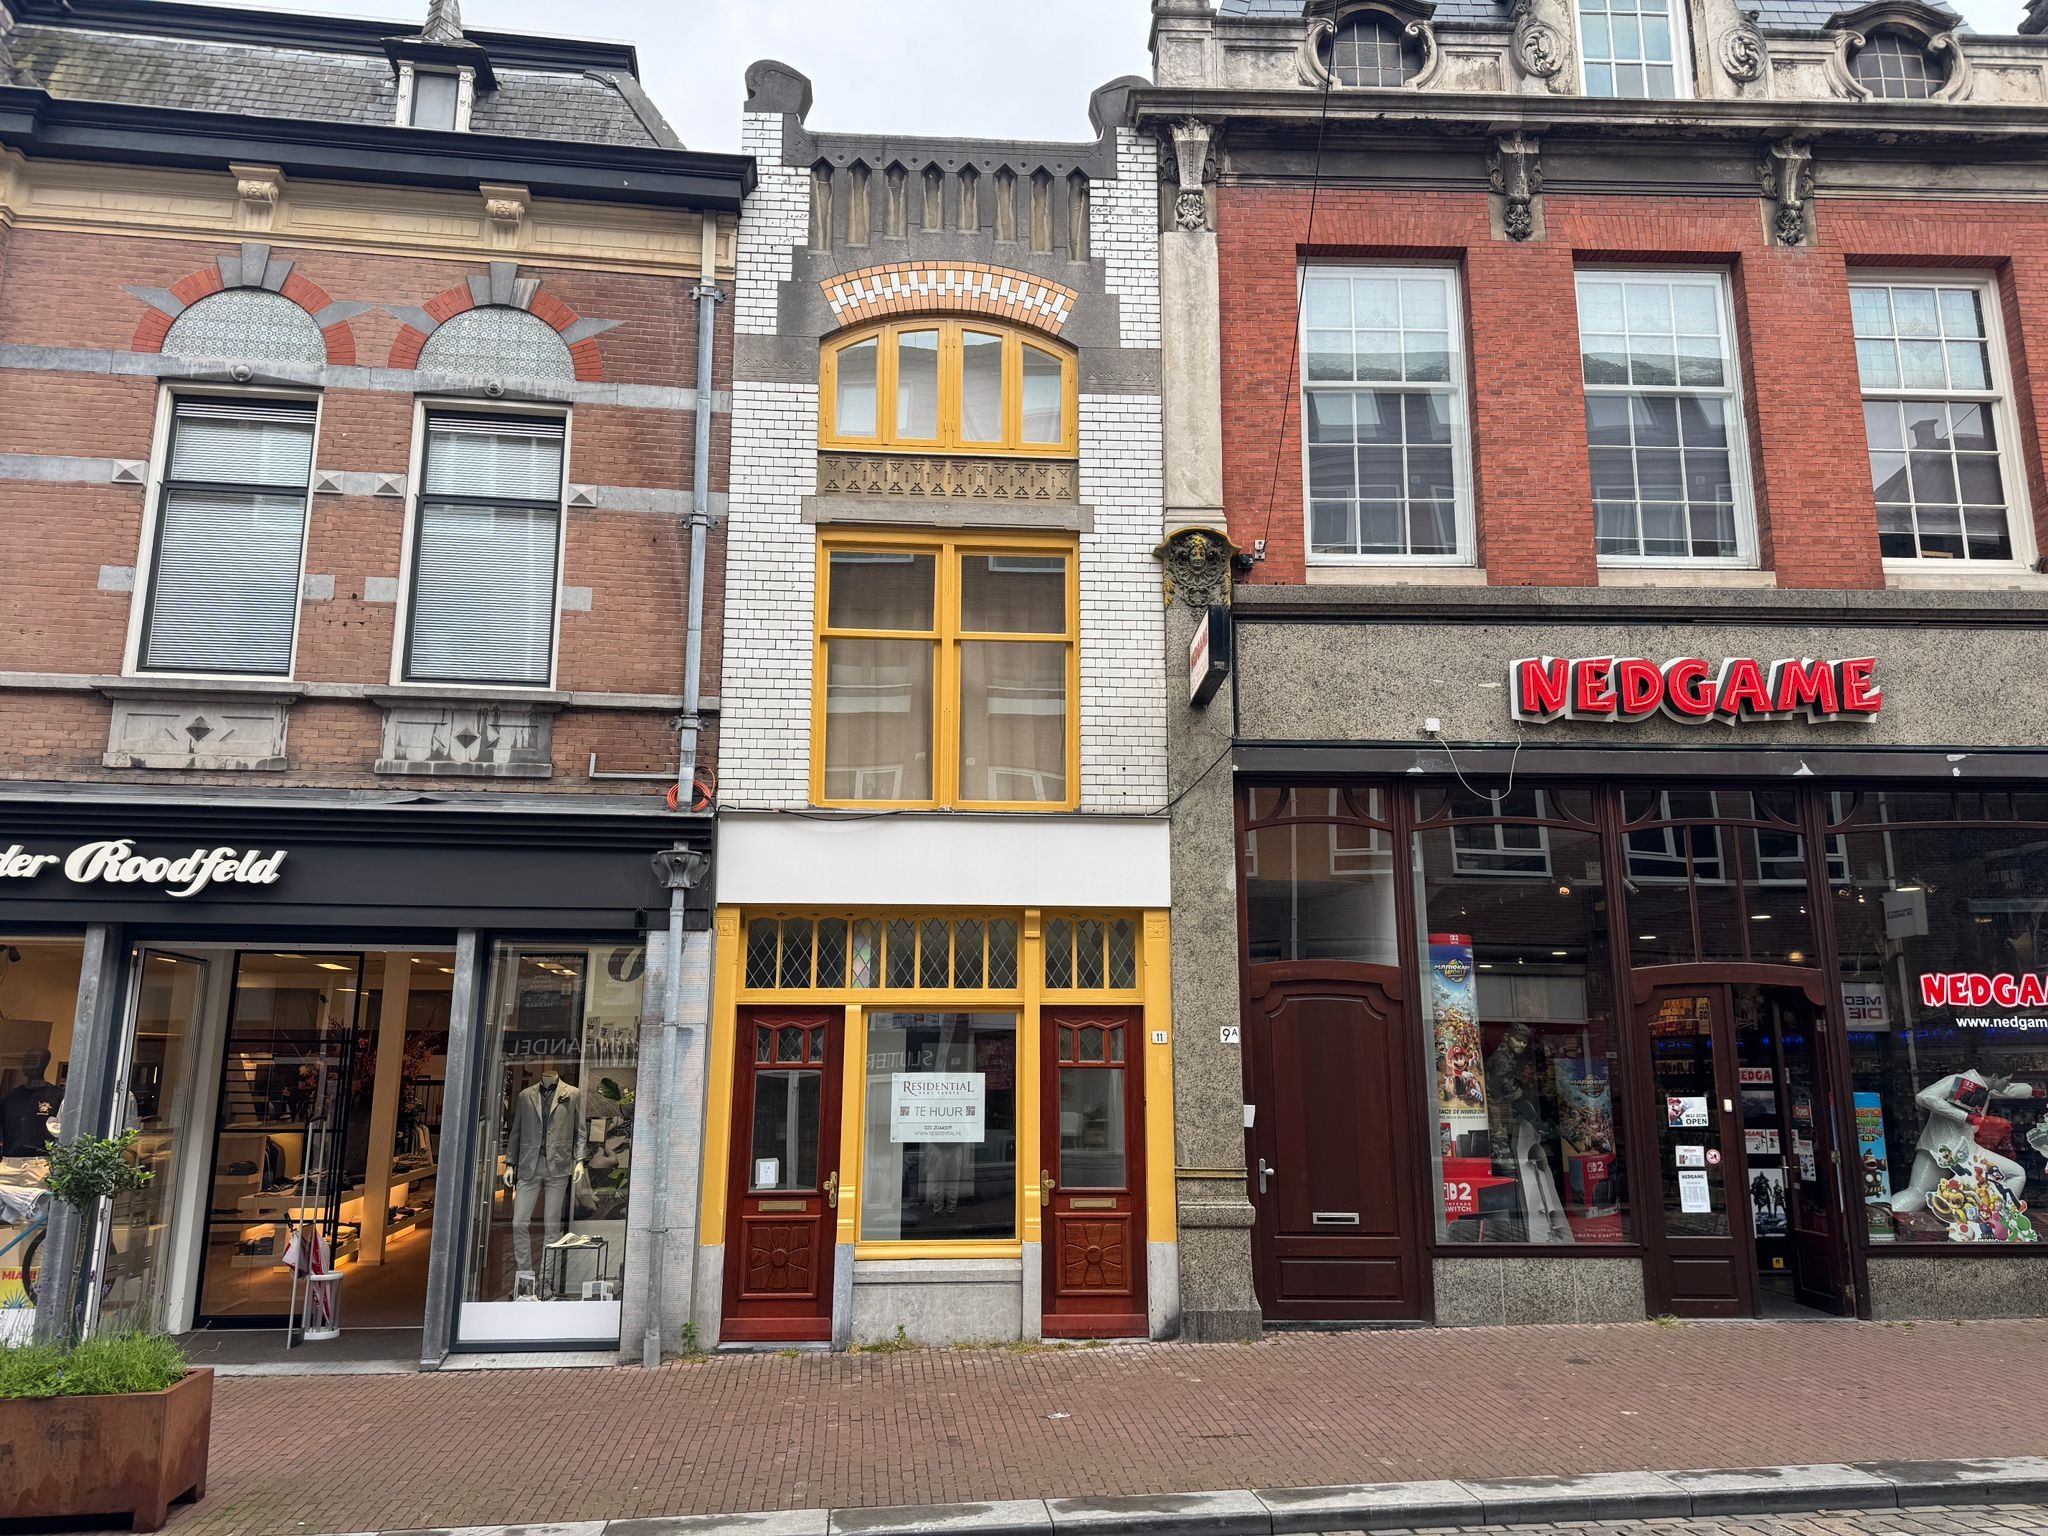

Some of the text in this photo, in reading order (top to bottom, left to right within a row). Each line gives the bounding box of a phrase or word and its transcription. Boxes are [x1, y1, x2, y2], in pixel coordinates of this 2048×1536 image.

[1509, 655, 1883, 726] NEDGAME
[65, 839, 288, 897] Roodfeld
[1920, 973, 2048, 1008] NEDGA
[1156, 1033, 1163, 1042] 11
[903, 1080, 975, 1097] RESIDENTIAL
[914, 1106, 963, 1117] TE HUUR
[2, 1270, 37, 1281] MIAI
